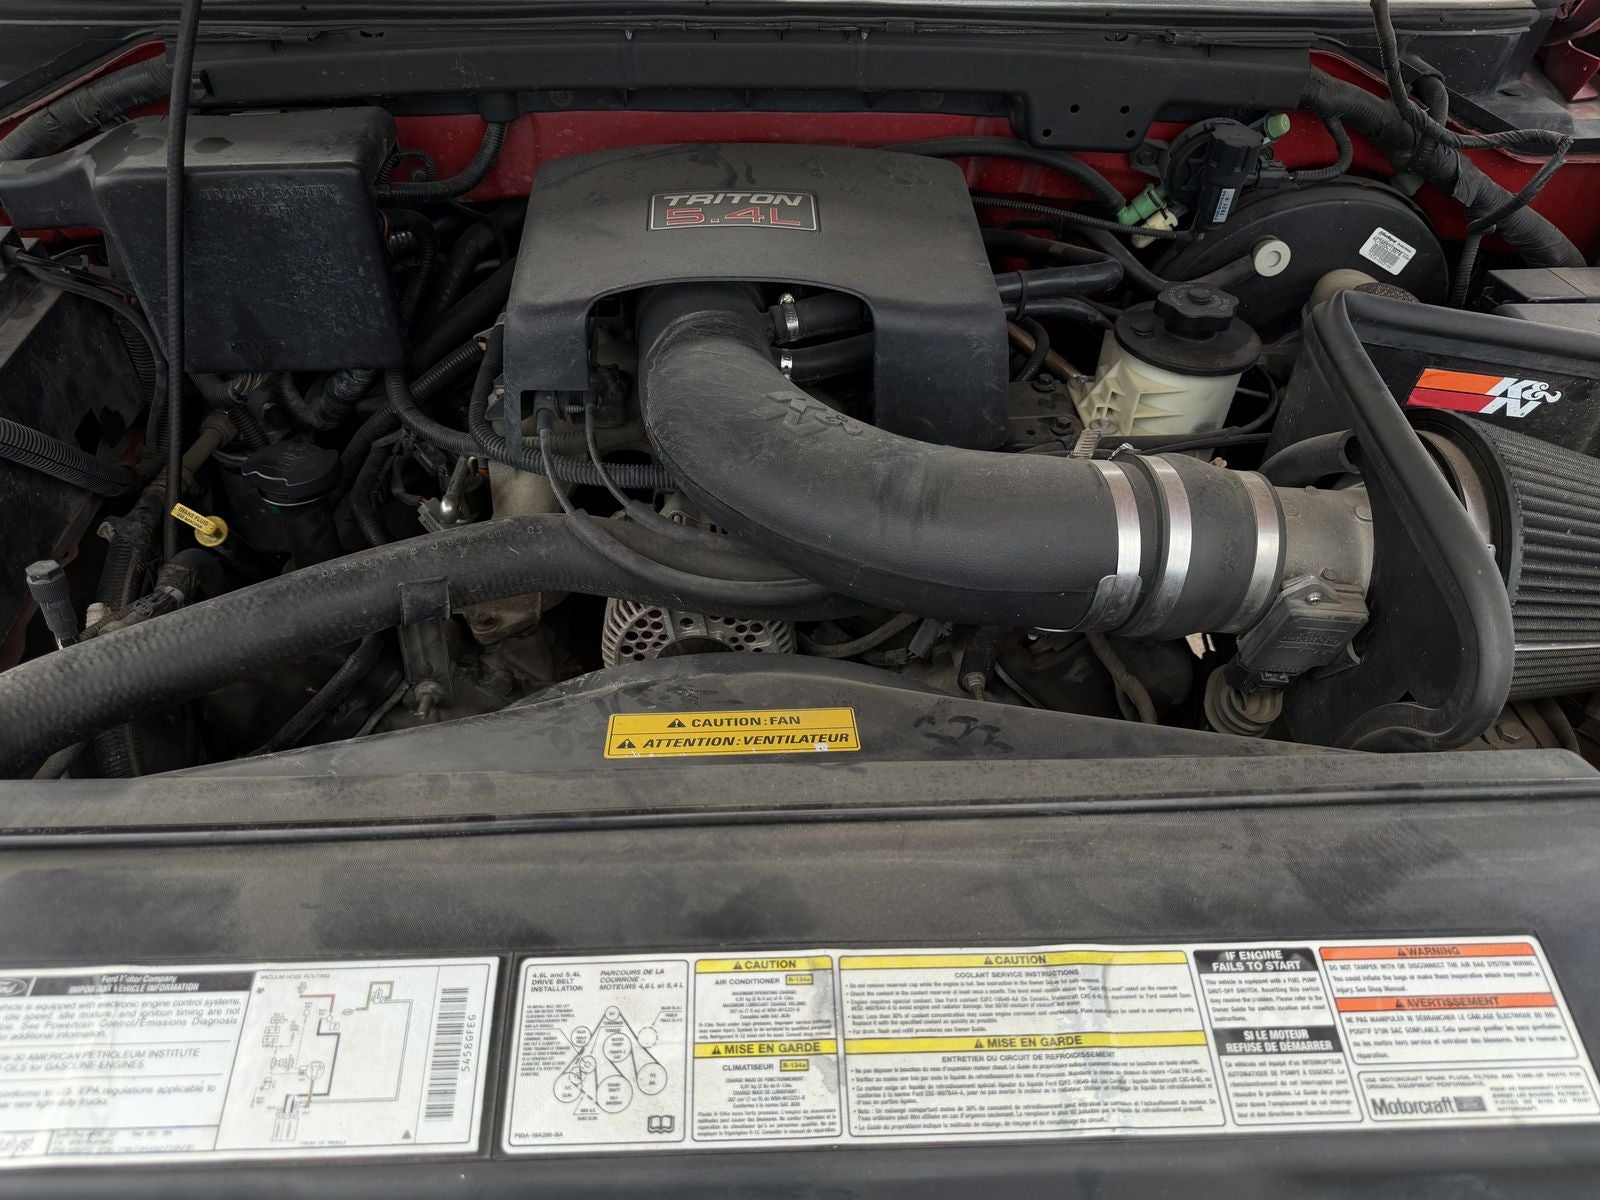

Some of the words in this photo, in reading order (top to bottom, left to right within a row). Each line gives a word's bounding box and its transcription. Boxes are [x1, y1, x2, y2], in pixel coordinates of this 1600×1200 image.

[664, 193, 803, 206] TRITON
[666, 207, 801, 226] 5.4L
[1479, 377, 1562, 418] K&N
[1225, 952, 1235, 960] IF
[1238, 950, 1282, 960] ENGINE
[1407, 946, 1460, 956] WARNING
[744, 960, 797, 970] CAUTION
[995, 956, 1046, 965] CAUTION
[1212, 962, 1244, 971] FAILS
[1246, 961, 1262, 971] TO
[1265, 960, 1301, 970] START
[1025, 969, 1079, 977] INSTRUCTIONS
[532, 978, 553, 986] DRIVE
[67, 985, 111, 994] IMPORANT
[1407, 996, 1500, 1008] AVERTISSEMENT
[1243, 1030, 1254, 1040] SI
[1255, 1030, 1267, 1040] LE
[1269, 1029, 1309, 1040] MOTEUR
[987, 1038, 1016, 1048] MISE
[1020, 1037, 1036, 1047] EN
[1039, 1036, 1082, 1047] GARDE
[1226, 1042, 1261, 1053] REFUSE
[1264, 1041, 1276, 1052] DE
[724, 1044, 754, 1054] MISE
[758, 1043, 774, 1053] EN
[778, 1042, 820, 1053] GARDE
[941, 1055, 984, 1063] ENTRETIEN
[986, 1054, 997, 1062] DU
[1045, 1052, 1115, 1060] REFROIDISSEMENT
[722, 1063, 774, 1071] CLIMATISEUR
[1371, 1096, 1455, 1116] Motorcraft
